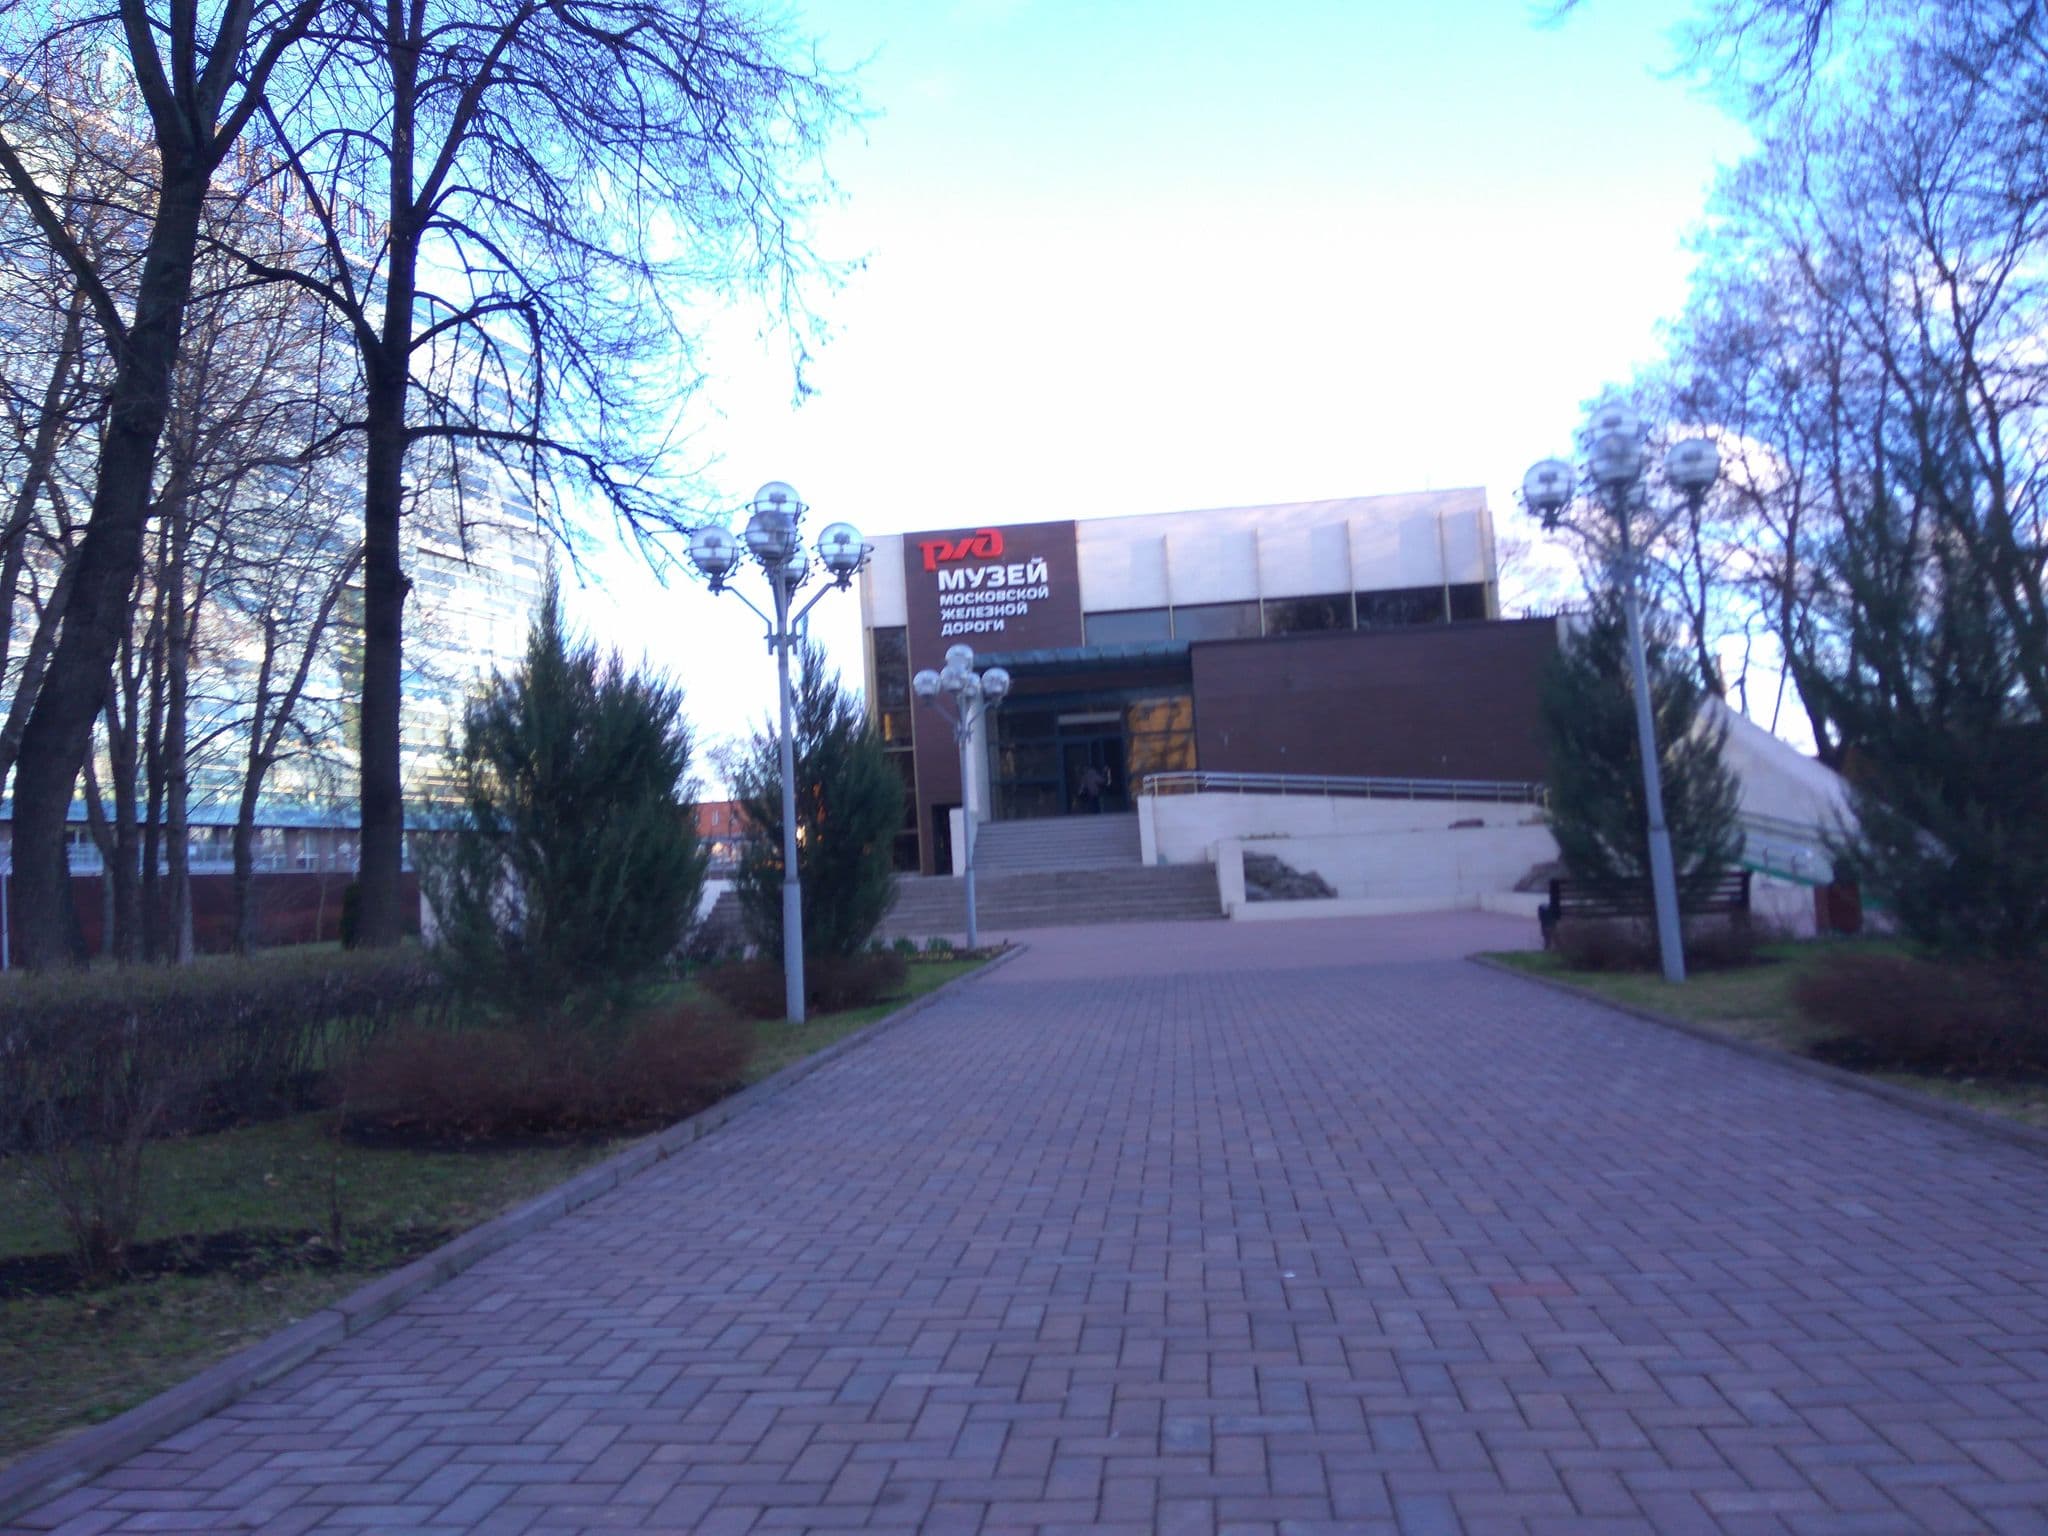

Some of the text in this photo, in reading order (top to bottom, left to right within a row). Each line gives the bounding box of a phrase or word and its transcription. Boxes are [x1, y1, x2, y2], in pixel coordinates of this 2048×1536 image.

[938, 556, 1048, 591] МУЗЕЙ
[939, 586, 1049, 607] МОСКОВСКОЙ
[940, 601, 1028, 621] ЖЕЛЕЗНОЙ
[941, 619, 1005, 637] ДОРОГИ
